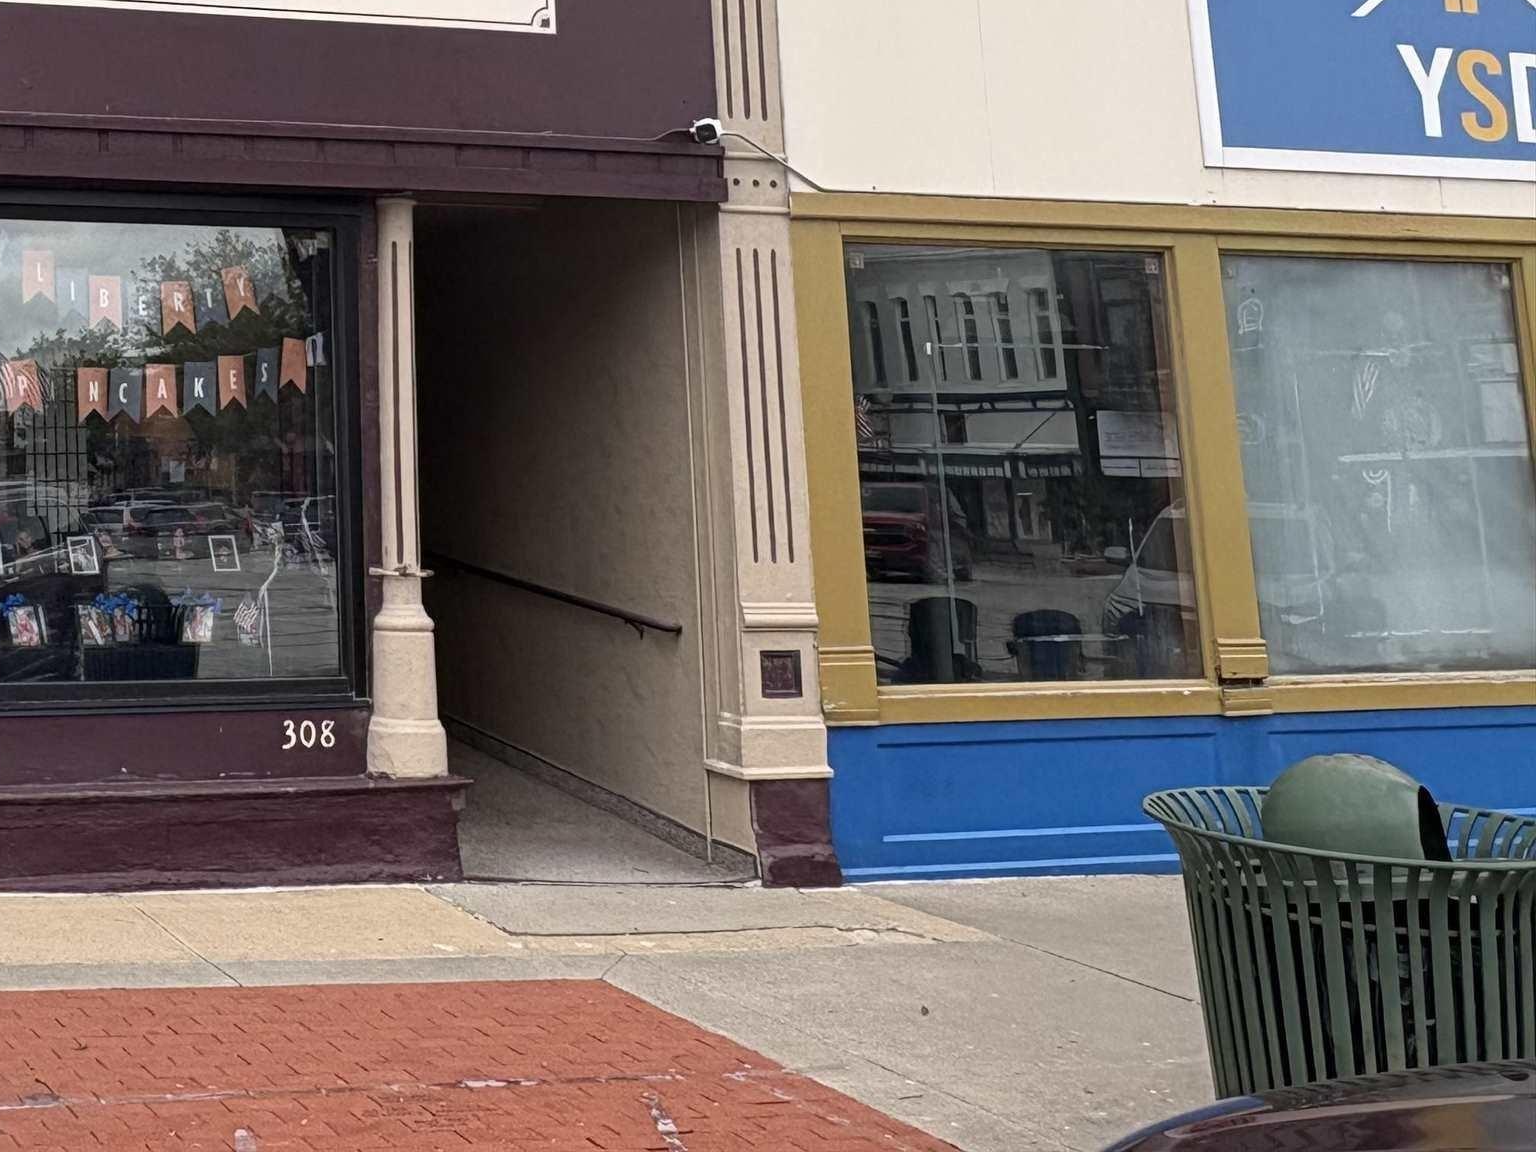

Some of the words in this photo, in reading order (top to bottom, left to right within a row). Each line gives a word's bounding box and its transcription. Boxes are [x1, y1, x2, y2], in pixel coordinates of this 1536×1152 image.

[36, 261, 246, 317] LIBERTY
[17, 362, 268, 404] PNCAKES
[282, 719, 336, 750] 308
